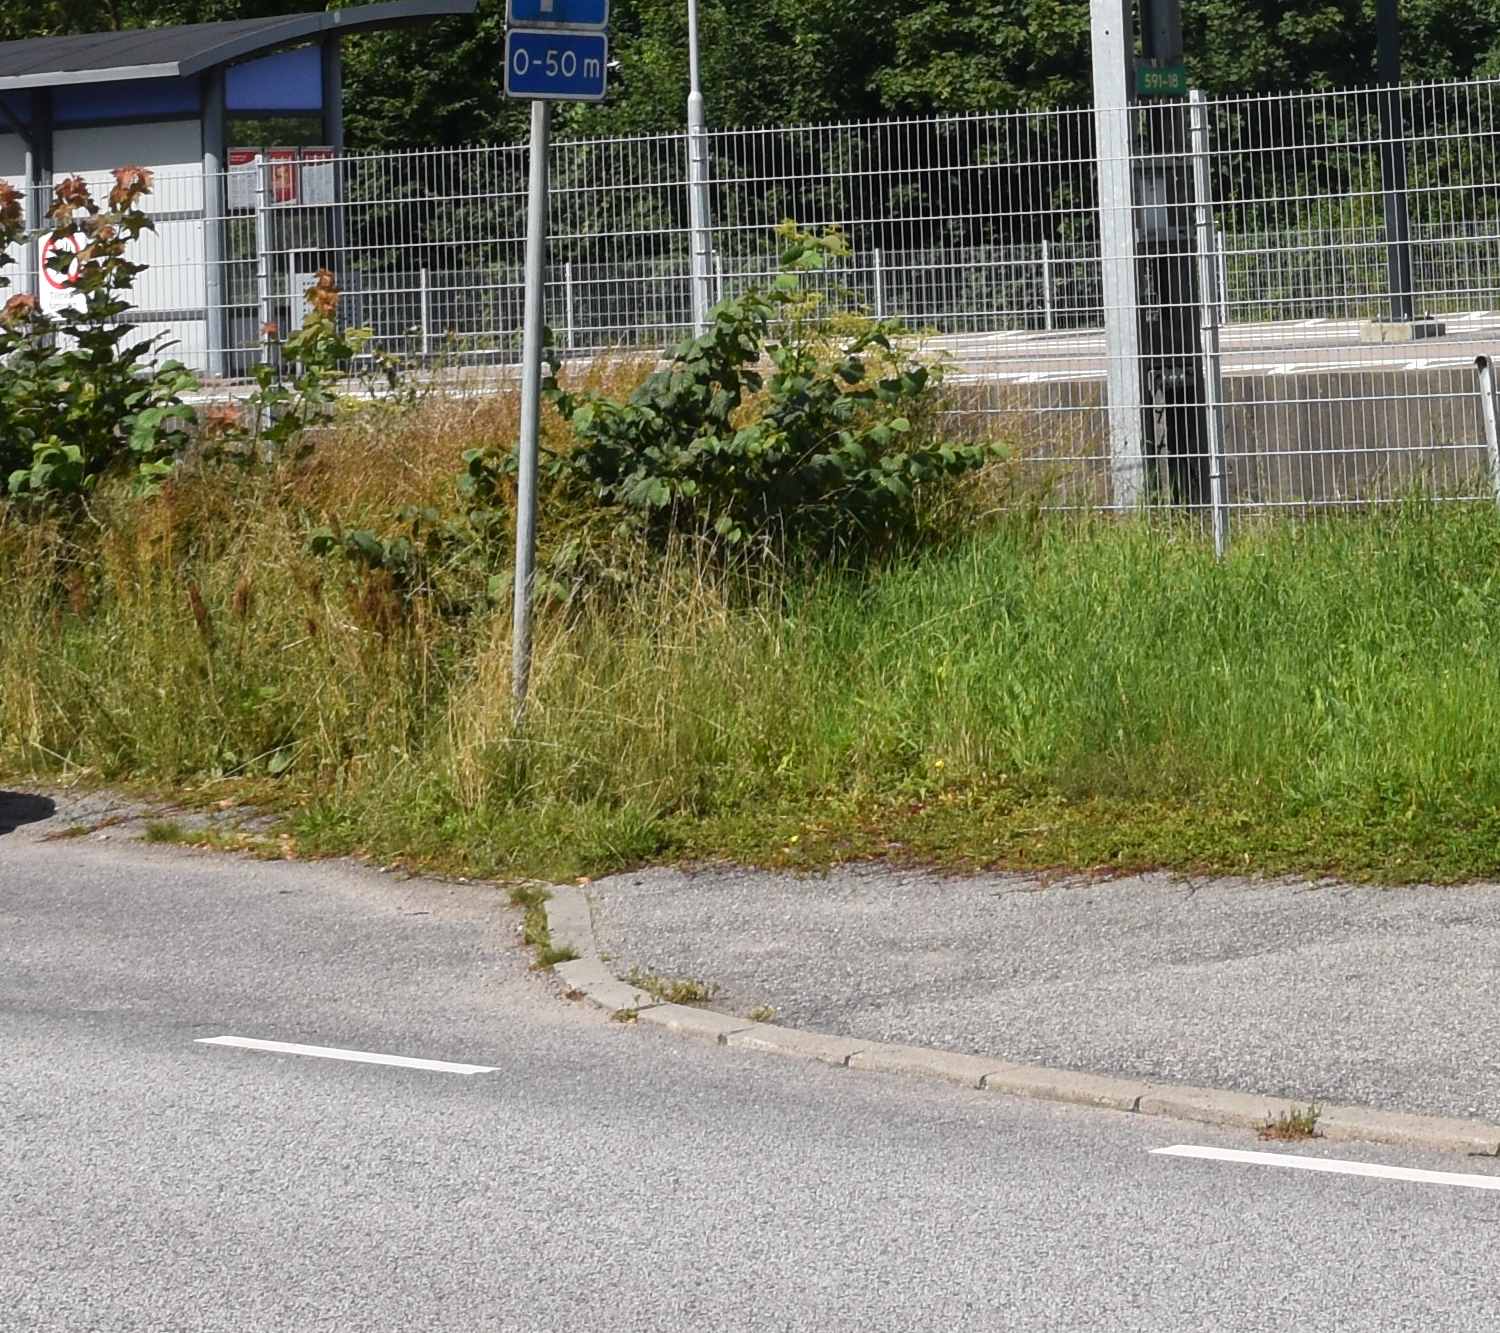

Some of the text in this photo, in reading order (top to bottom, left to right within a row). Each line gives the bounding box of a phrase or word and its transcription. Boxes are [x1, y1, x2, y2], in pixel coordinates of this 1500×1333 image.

[513, 48, 600, 78] 0-50 m
[1144, 73, 1178, 89] 591-18
